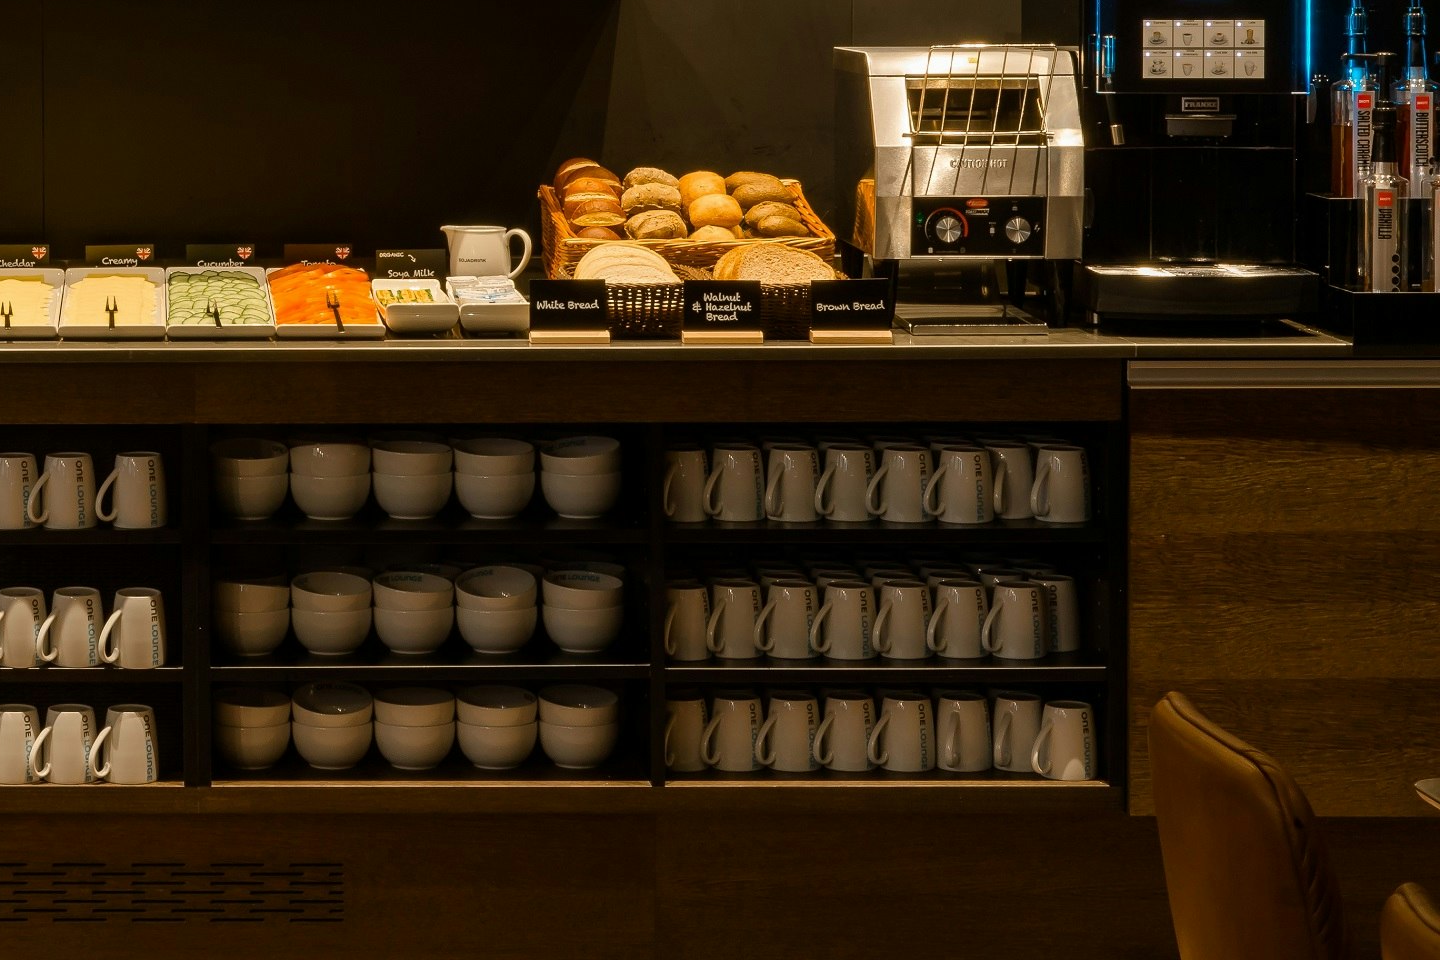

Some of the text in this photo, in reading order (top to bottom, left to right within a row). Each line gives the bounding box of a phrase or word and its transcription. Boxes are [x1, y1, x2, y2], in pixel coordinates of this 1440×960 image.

[1358, 111, 1370, 137] SALTED
[1416, 112, 1429, 167] BUTTERSCOTCH
[949, 159, 1008, 169] CAUTION HOT
[1378, 208, 1392, 239] VANILLA
[102, 257, 138, 268] Creamy
[197, 258, 244, 268] Cucumber
[388, 269, 435, 279] Soya Milk
[536, 299, 599, 311] White Bread
[703, 292, 741, 303] Walnut
[692, 302, 752, 313] & Hazelnut
[816, 300, 885, 313] Brown Bread
[706, 312, 738, 322] Bread
[75, 460, 84, 483] ONE
[147, 459, 156, 482] ONE
[974, 455, 983, 477] ONE
[150, 600, 159, 622] ONE
[918, 703, 926, 725] ONE
[143, 714, 152, 737] ONE
